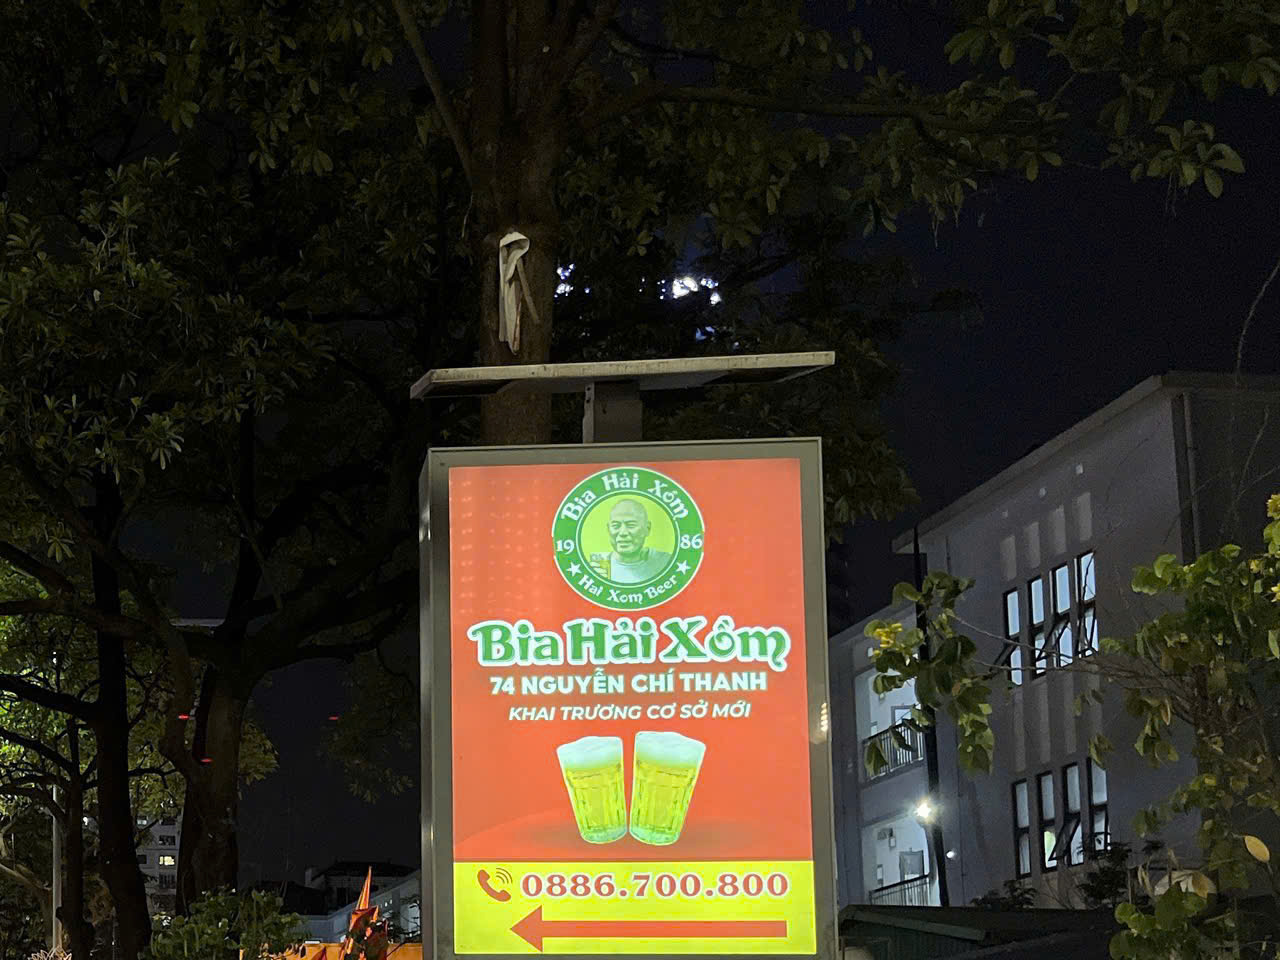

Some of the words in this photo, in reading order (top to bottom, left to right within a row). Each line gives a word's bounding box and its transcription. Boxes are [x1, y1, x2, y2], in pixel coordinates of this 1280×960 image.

[560, 489, 598, 521] Bia
[601, 473, 640, 491] Hải
[556, 539, 575, 554] 19
[680, 533, 703, 549] 86
[578, 574, 604, 597] Hai
[607, 589, 644, 604] Xom
[644, 574, 678, 600] Beer
[468, 619, 563, 665] Bia
[564, 616, 658, 664] Hải
[660, 616, 790, 671] Xồm
[489, 676, 516, 695] 74
[521, 667, 624, 695] NGUYỄN
[631, 667, 675, 693] CHÍ
[679, 671, 768, 692] THANH
[508, 706, 556, 721] KHAI
[560, 703, 642, 721] TRƯƠNG
[646, 703, 677, 719] CƠ
[679, 698, 709, 719] SỞ
[711, 699, 752, 719] MỚI
[521, 872, 790, 898] 0886.700.800
